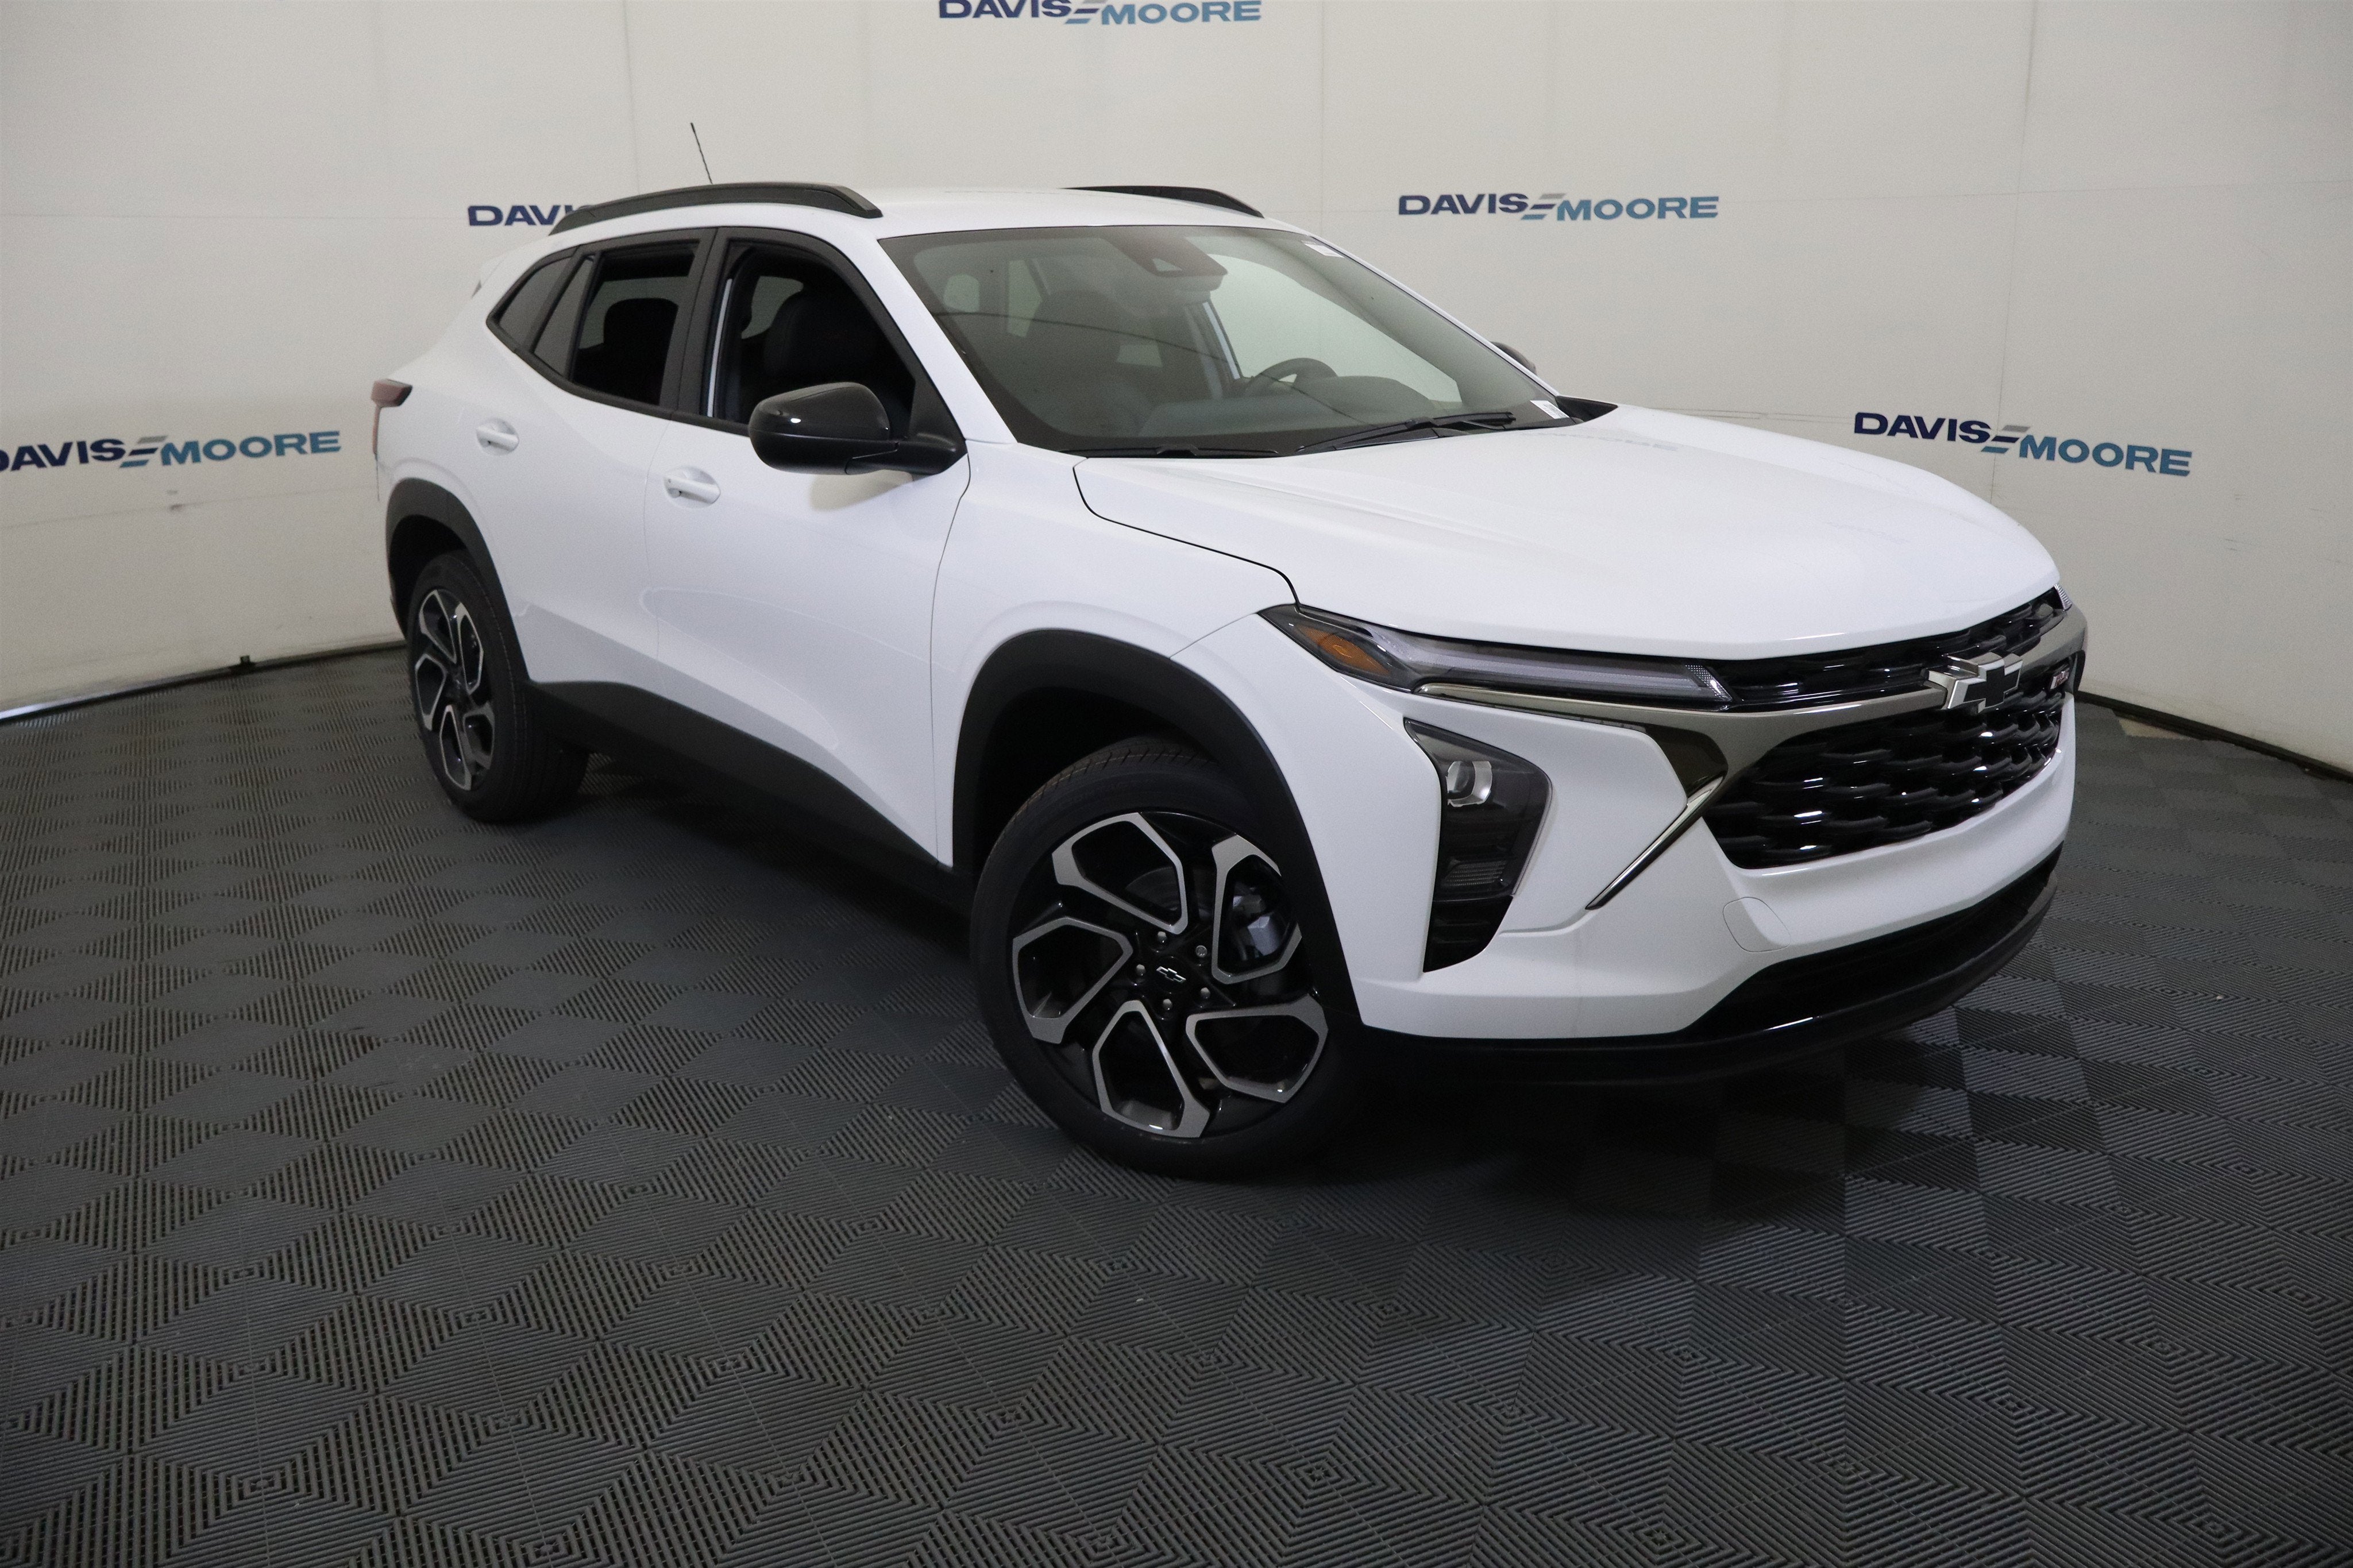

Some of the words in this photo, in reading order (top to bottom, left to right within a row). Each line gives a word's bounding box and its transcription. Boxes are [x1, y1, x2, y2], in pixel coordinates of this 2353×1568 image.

[939, 0, 1072, 18] DAVIS
[1101, 0, 1262, 25] MOORE
[1398, 194, 1528, 215] DAVIS
[1556, 196, 1719, 221] MOORE
[161, 430, 341, 466] MOORE
[1854, 412, 1991, 444] DAVIS
[2019, 434, 2193, 476] MOORE
